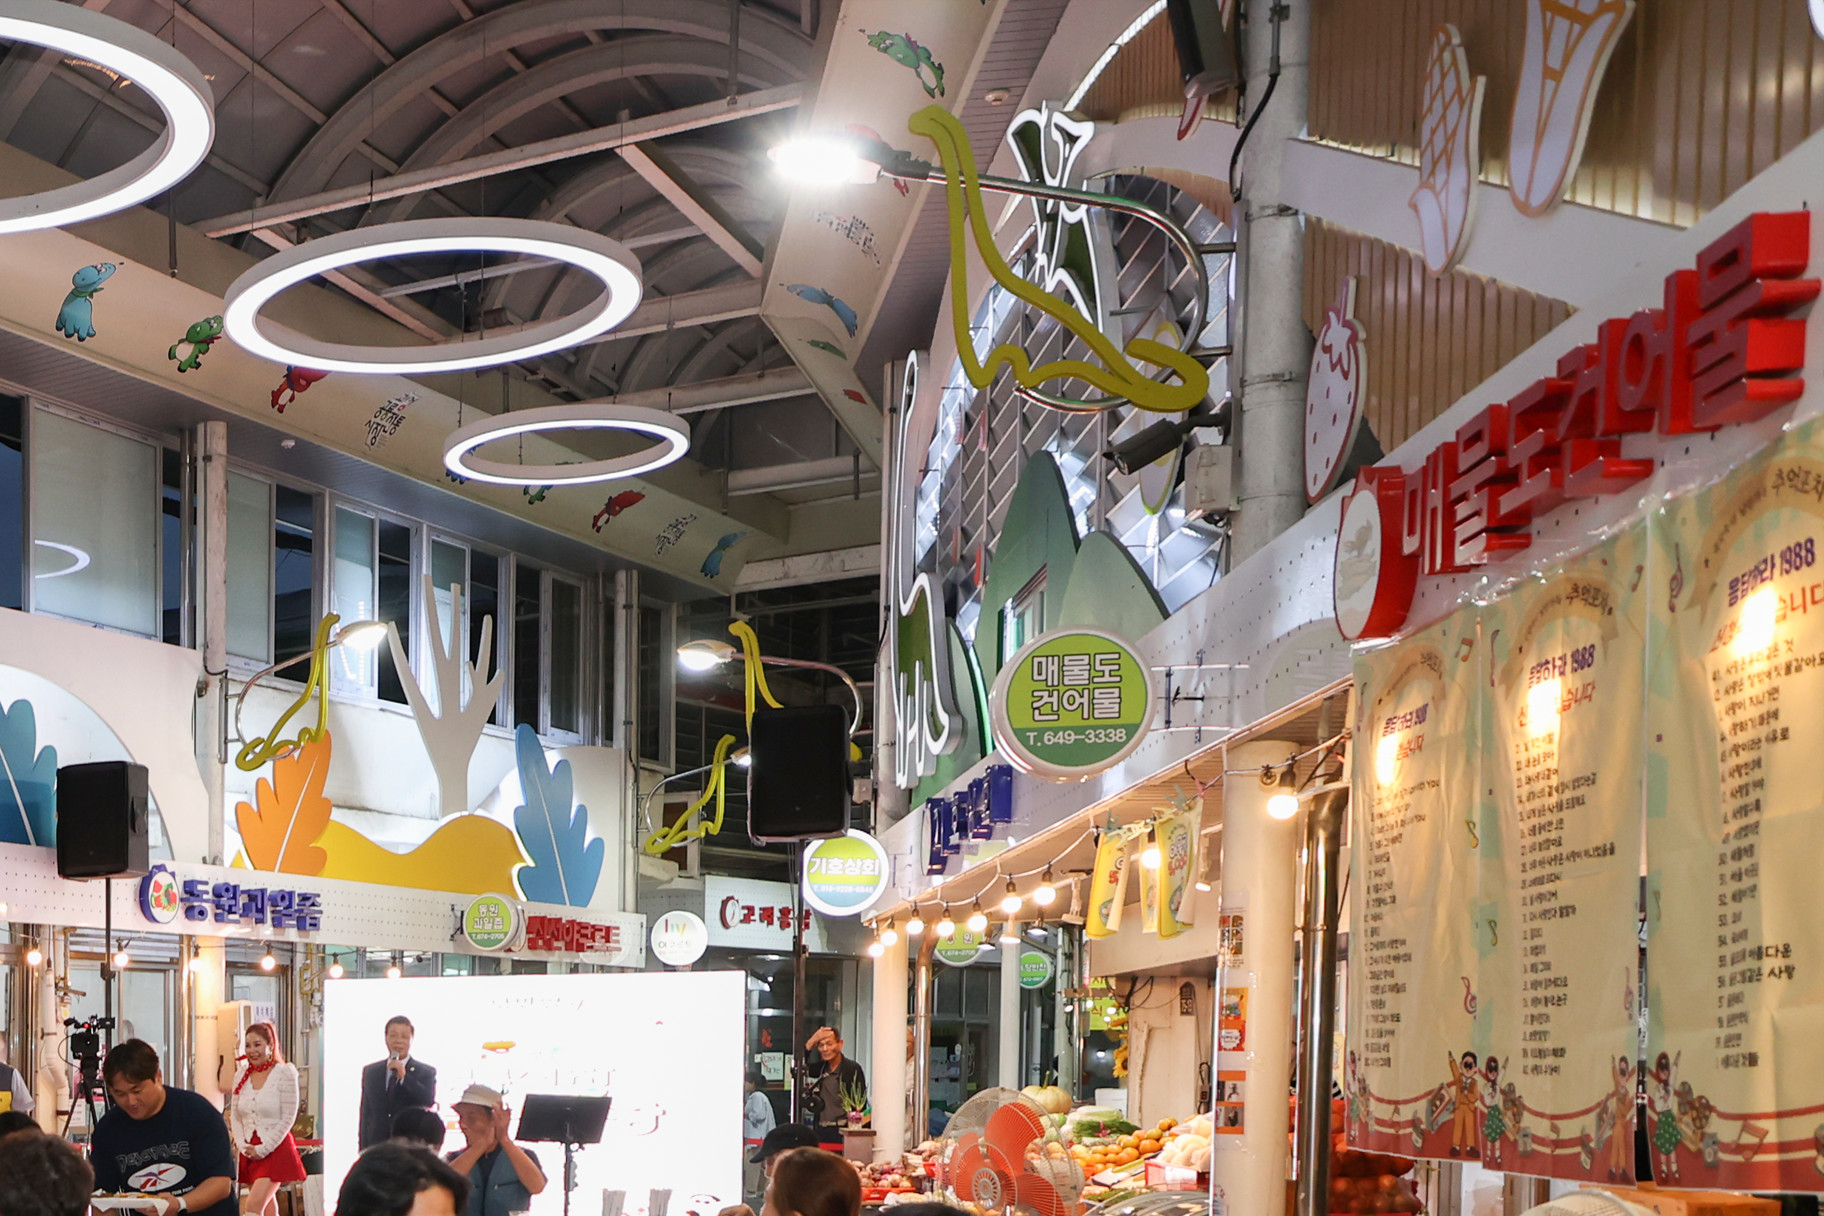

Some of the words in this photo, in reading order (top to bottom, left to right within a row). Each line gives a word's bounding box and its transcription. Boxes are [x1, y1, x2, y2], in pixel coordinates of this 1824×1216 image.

[1402, 209, 1822, 576] 매물도건어물
[1779, 536, 1816, 577] 1988
[1030, 651, 1122, 686] 매물도
[1030, 687, 1122, 722] 건어물
[809, 857, 880, 877] 기호상회
[473, 917, 504, 932] 과일즙
